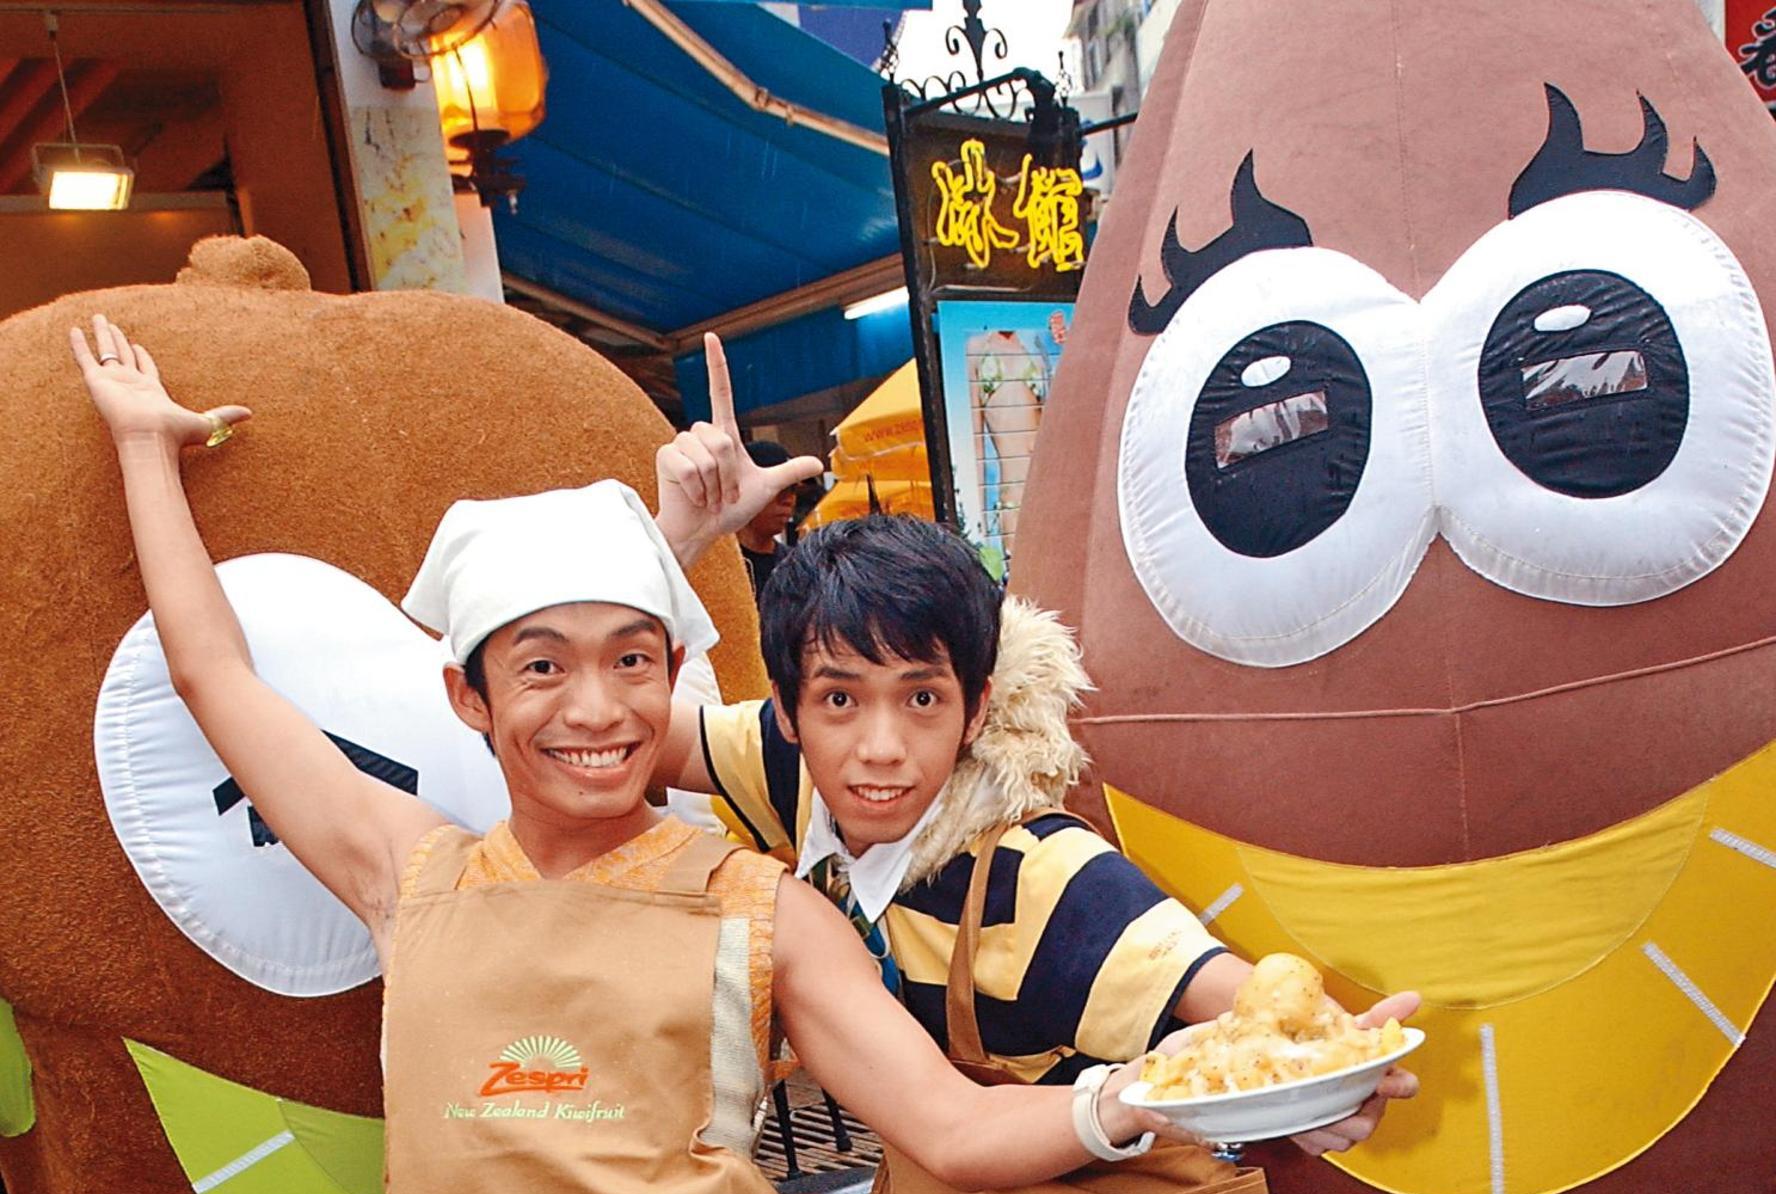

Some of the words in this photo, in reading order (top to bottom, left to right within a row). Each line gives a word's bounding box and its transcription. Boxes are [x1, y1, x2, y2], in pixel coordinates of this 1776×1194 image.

[478, 1062, 590, 1098] Zespri
[443, 1102, 477, 1119] New
[479, 1099, 550, 1119] Zealand
[554, 1100, 625, 1123] Kiwifruit
